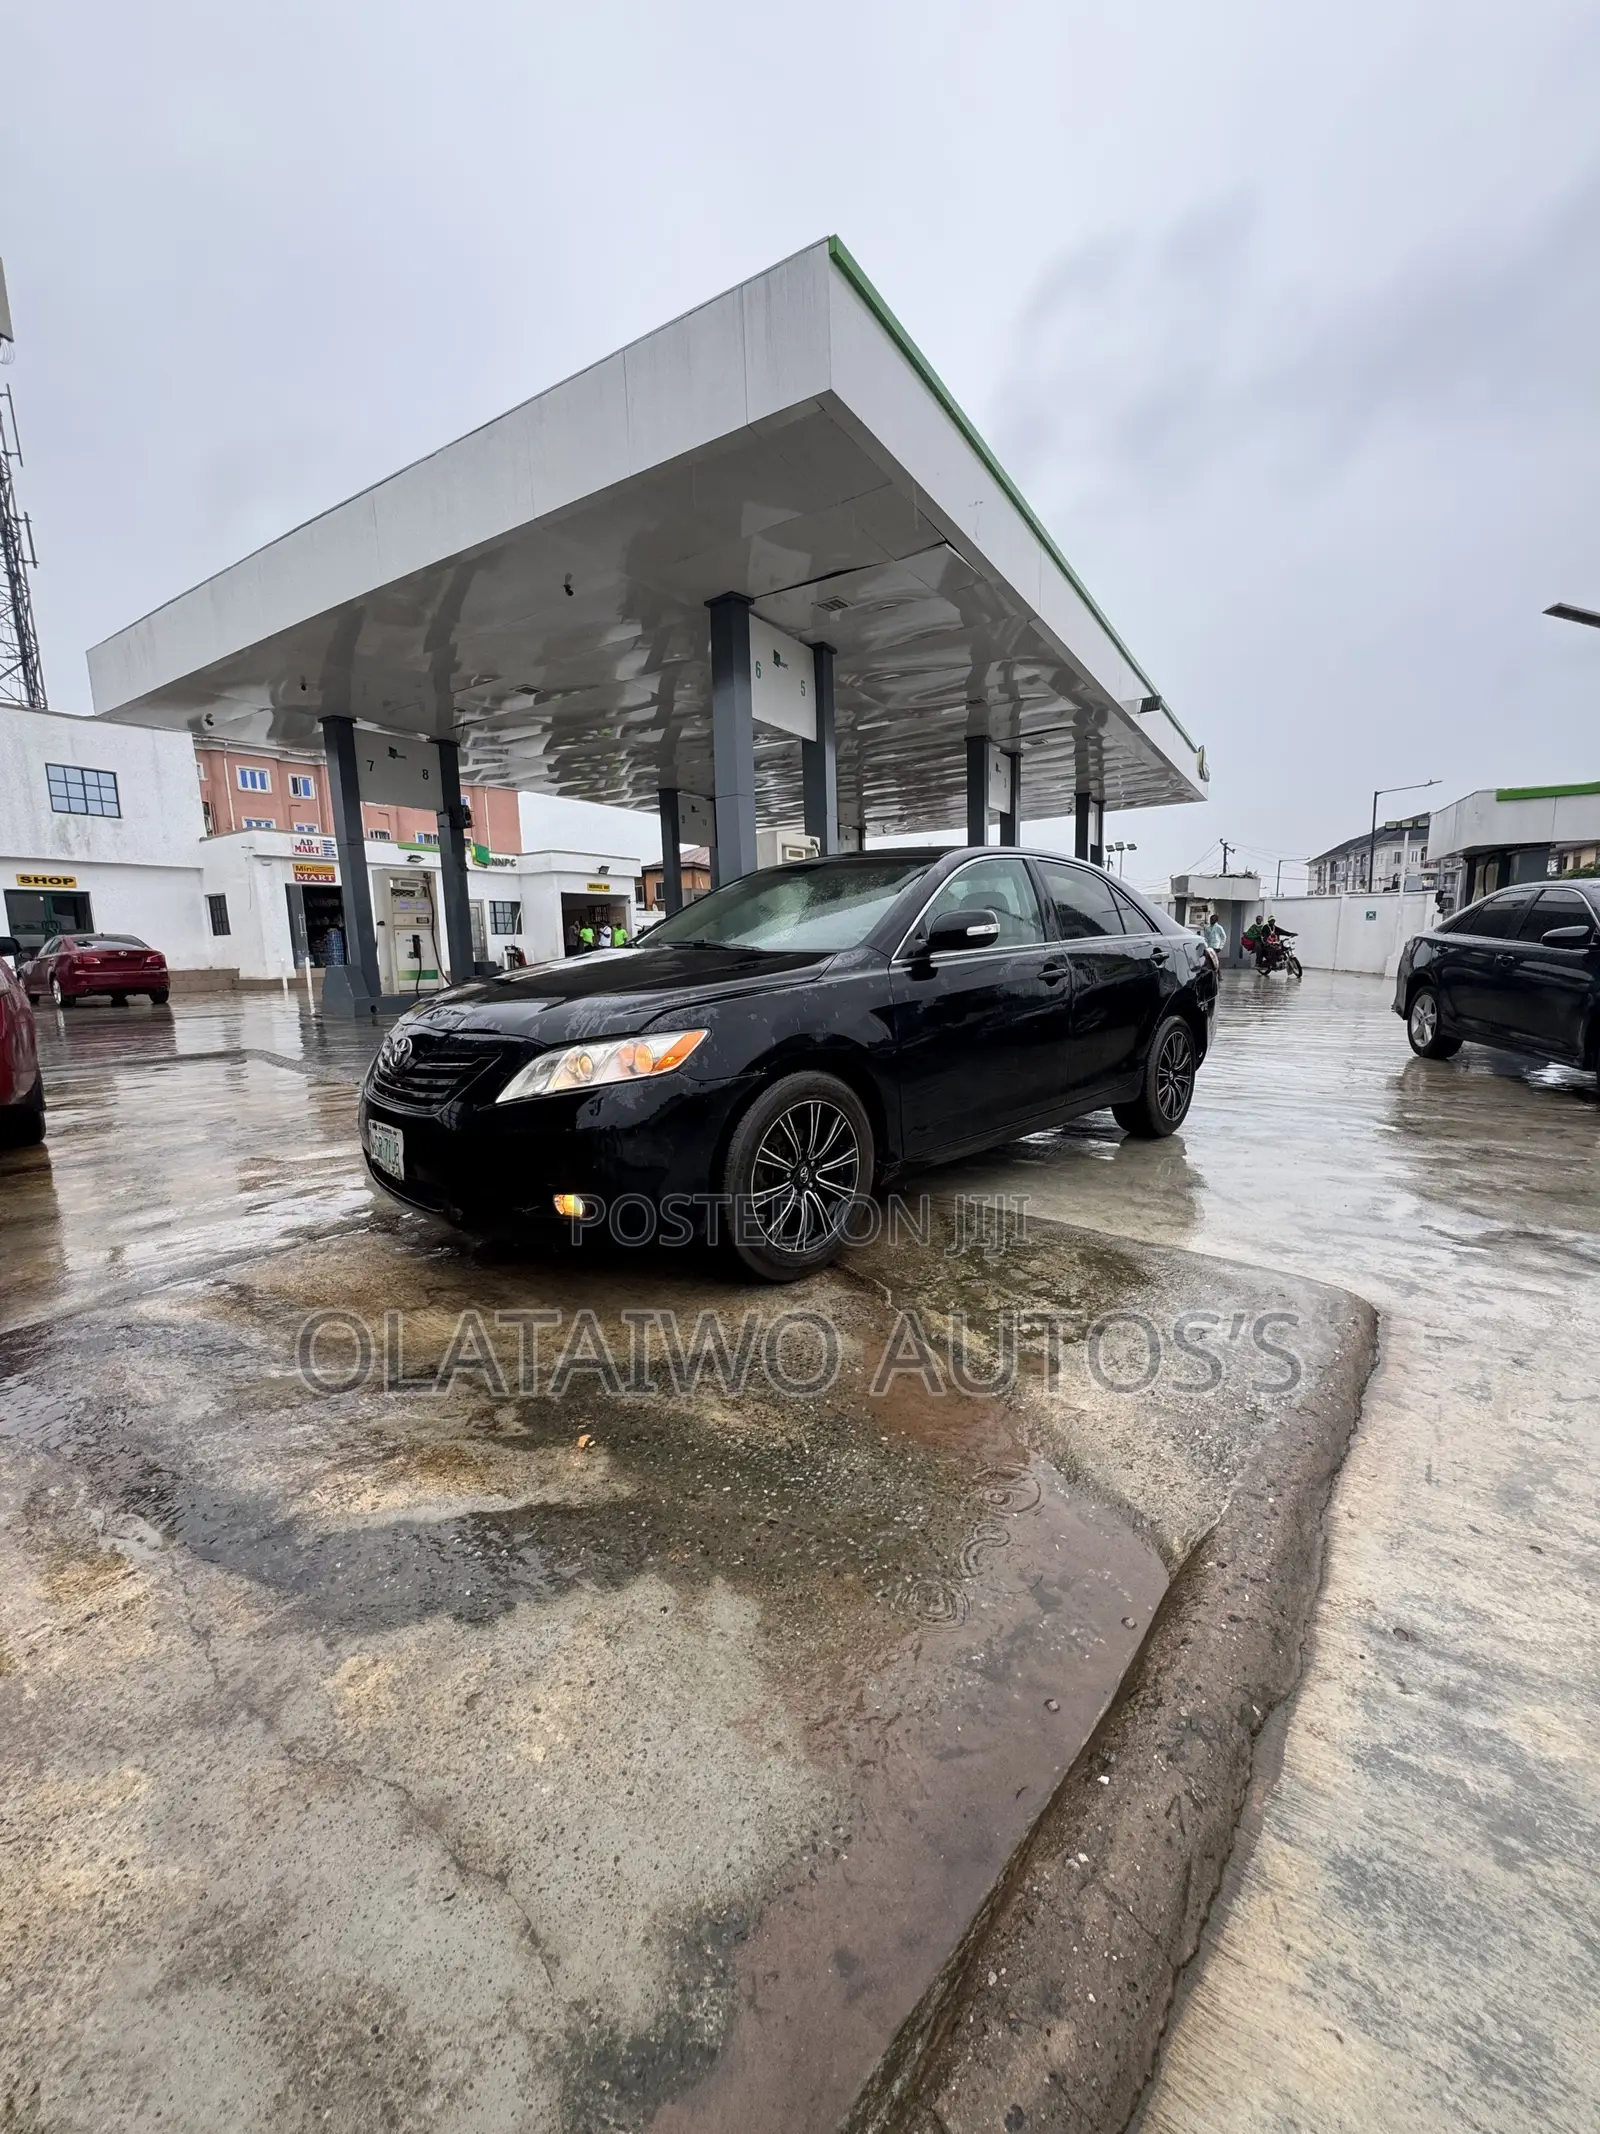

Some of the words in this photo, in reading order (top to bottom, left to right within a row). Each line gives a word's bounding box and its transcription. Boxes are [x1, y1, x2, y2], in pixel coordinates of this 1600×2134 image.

[755, 660, 762, 680] 6
[800, 679, 806, 697] 5
[366, 759, 375, 772] 7
[422, 768, 430, 780] 8
[300, 838, 313, 846] AD
[294, 844, 320, 854] MART
[491, 857, 517, 867] NNPC
[20, 876, 74, 885] SHOP
[296, 873, 335, 882] MART
